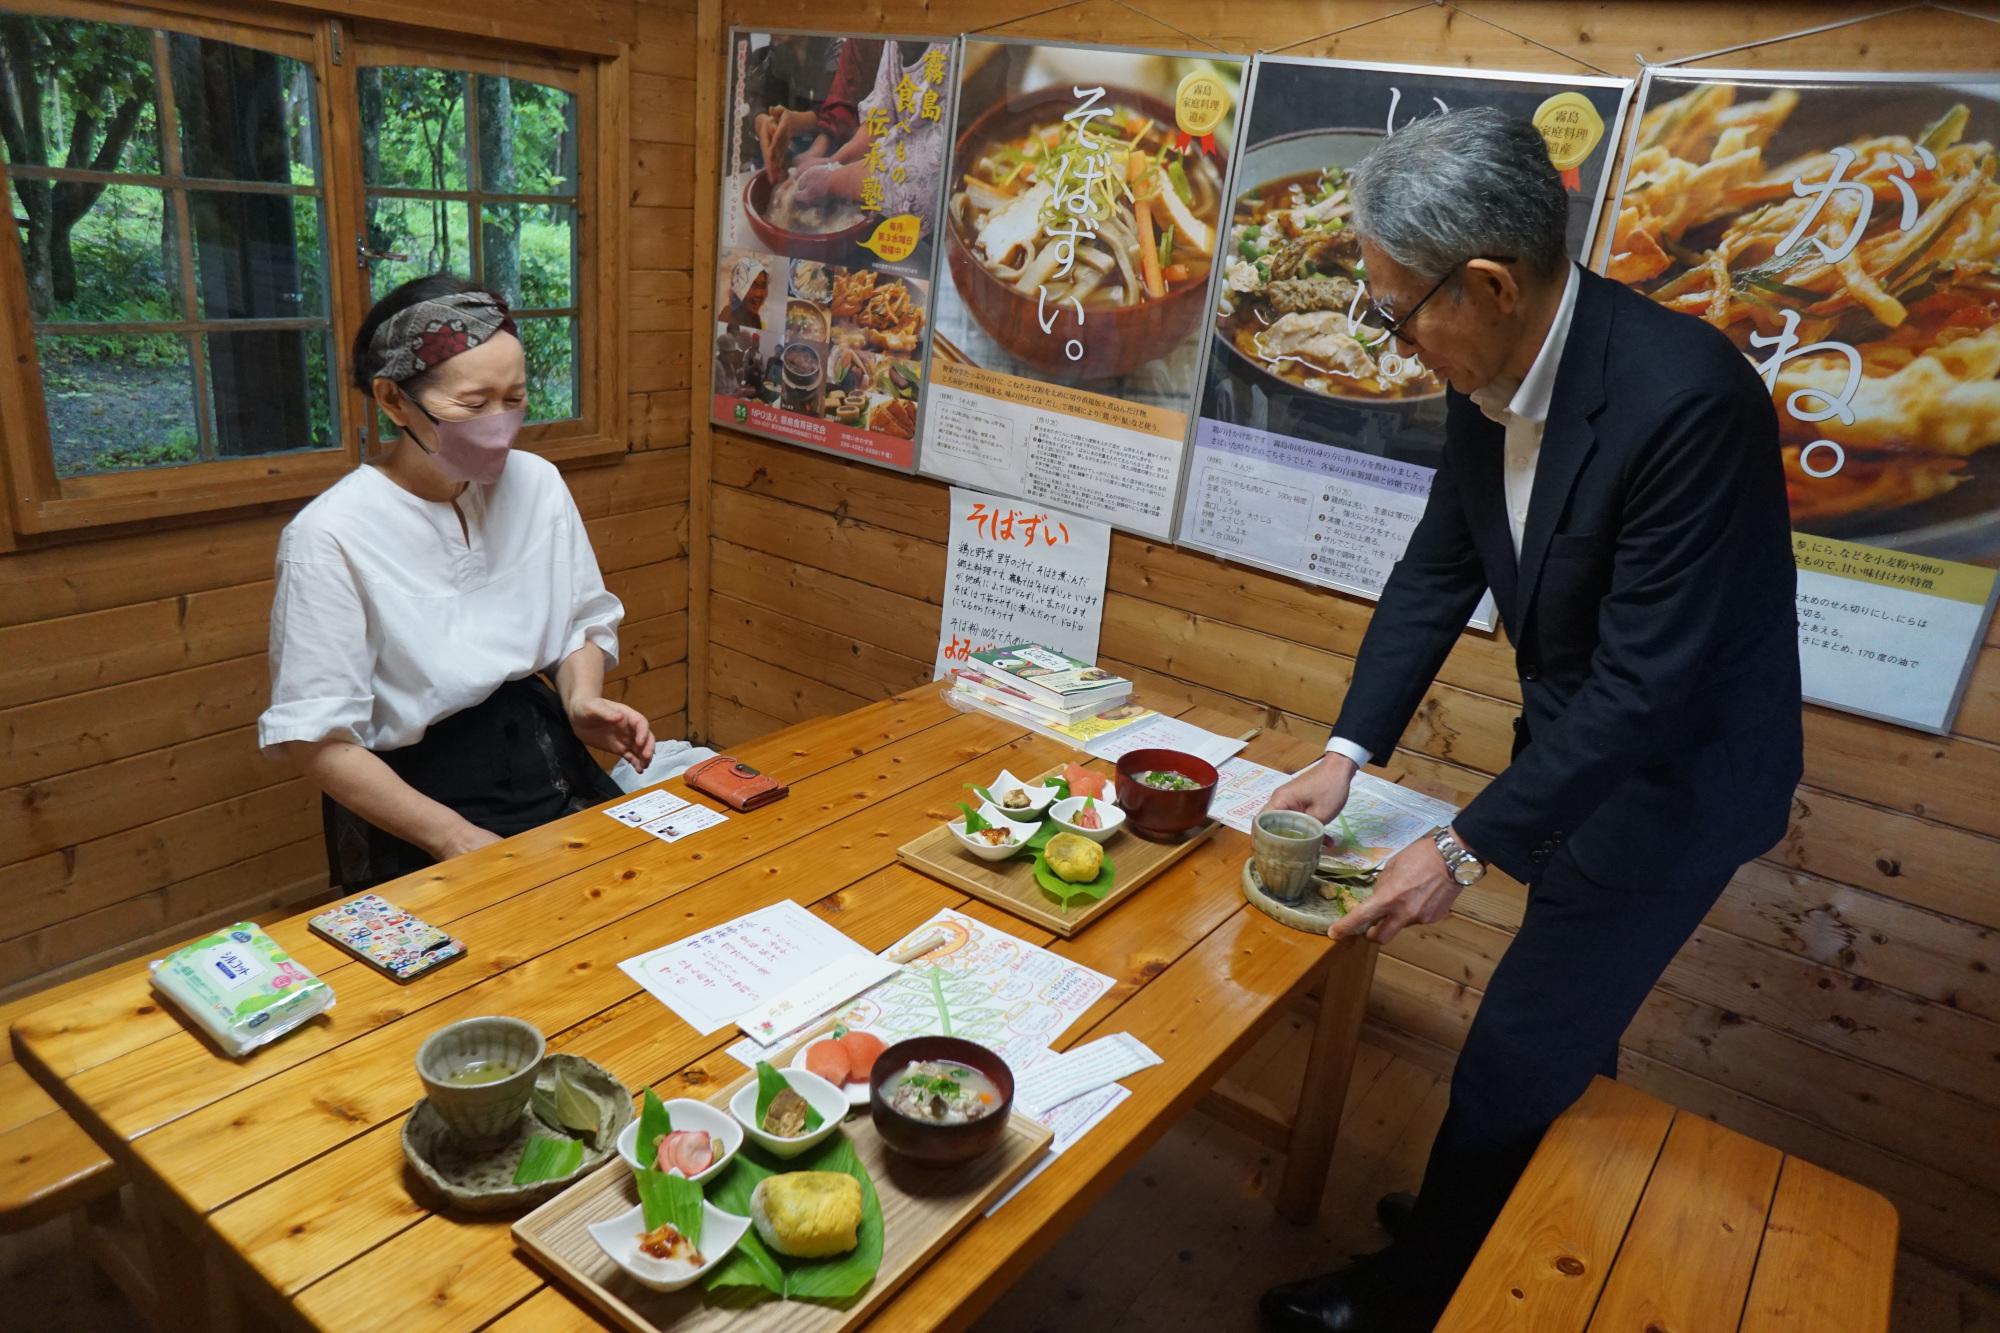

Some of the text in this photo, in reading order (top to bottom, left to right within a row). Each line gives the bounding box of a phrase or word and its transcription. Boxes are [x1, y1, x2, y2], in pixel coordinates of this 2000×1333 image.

[920, 50, 947, 121] 霧島
[1193, 84, 1212, 97] 霧島
[1182, 97, 1220, 111] 家庭料理
[1188, 111, 1207, 124] 遺産
[1555, 110, 1579, 124] 霧島
[892, 74, 921, 184] 食べもの
[1541, 125, 1588, 141] 家庭料理
[859, 106, 890, 212] 伝承塾
[889, 221, 903, 233] 毎月
[751, 408, 778, 423] NPO法人
[966, 503, 1069, 547] そばずい
[1792, 539, 1944, 576] 参、にら、などを小麦粉や卵の
[1797, 621, 1844, 639] とあえる。
[219, 949, 251, 977] シルコット
